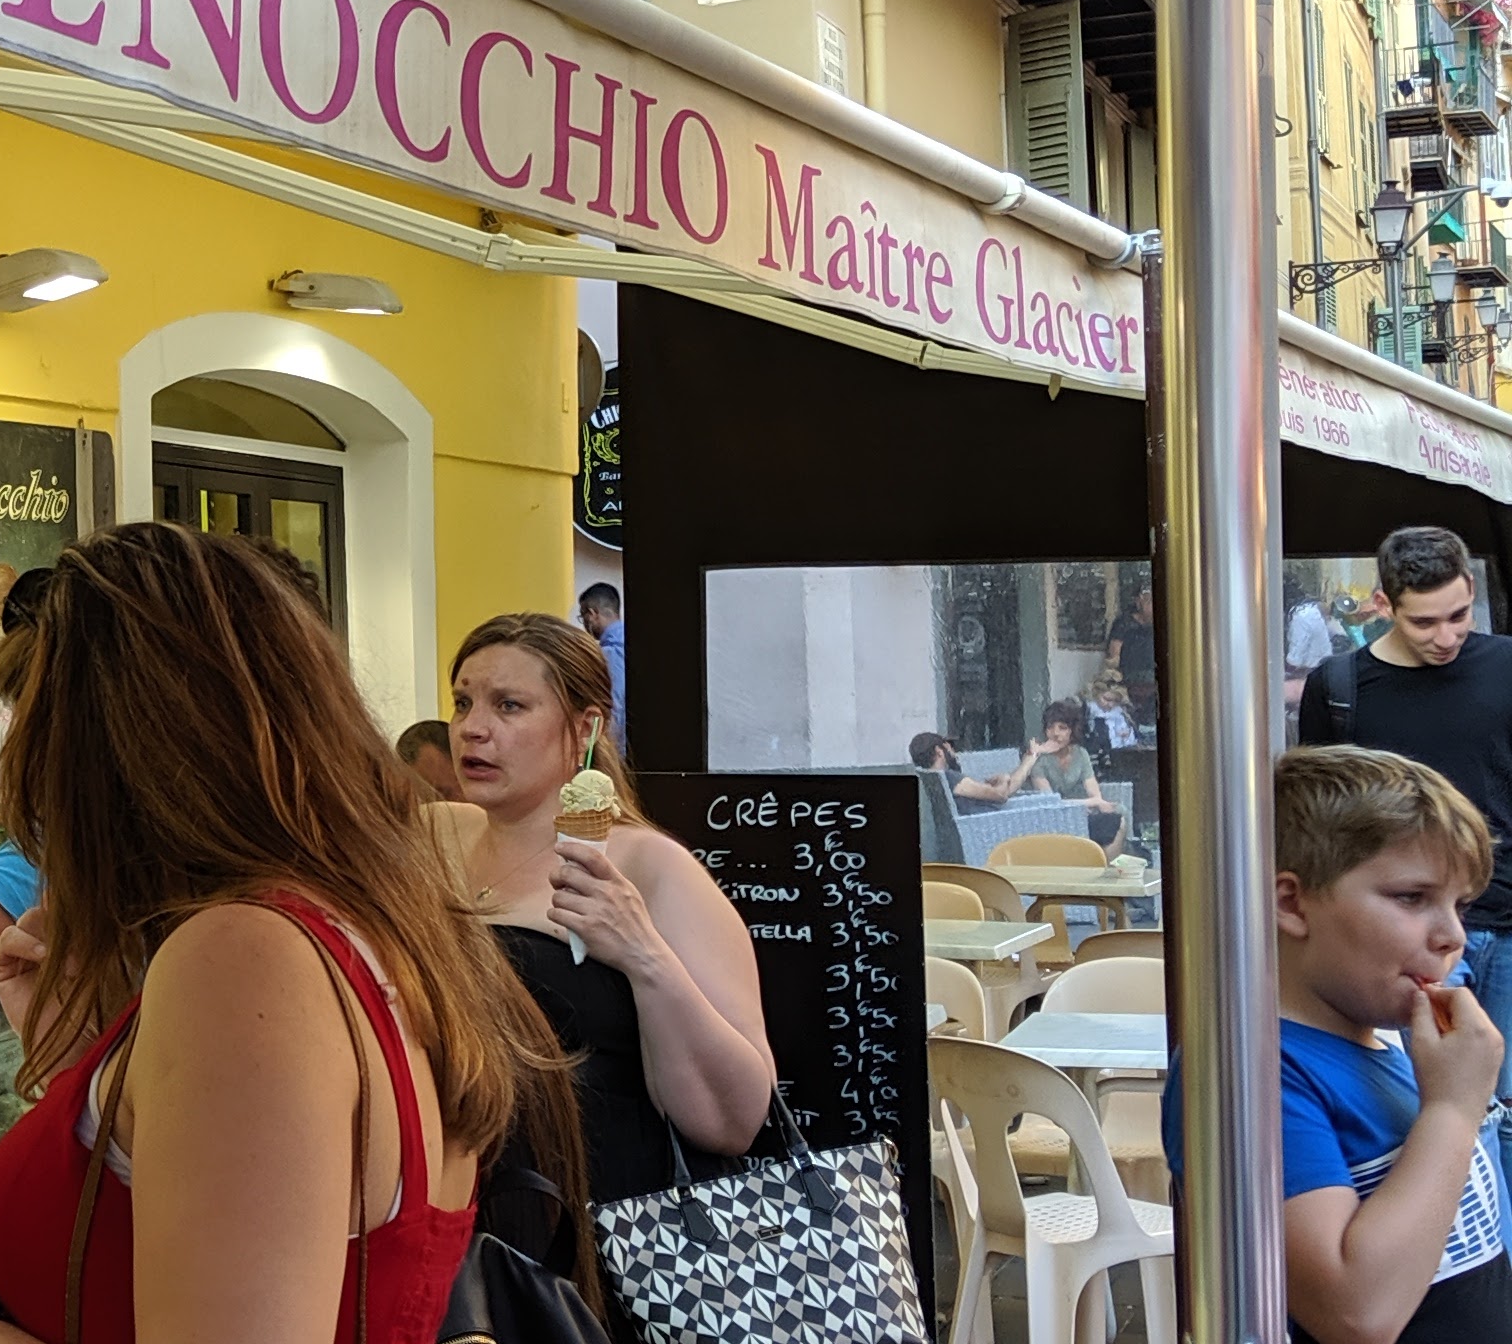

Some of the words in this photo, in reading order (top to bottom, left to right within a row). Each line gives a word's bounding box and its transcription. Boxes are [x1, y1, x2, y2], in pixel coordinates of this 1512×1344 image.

[754, 144, 953, 325] Maître
[976, 239, 1138, 374] Glacier
[1313, 415, 1350, 446] 1966
[707, 792, 867, 830] CRÊPES
[748, 924, 812, 943] TELLA
